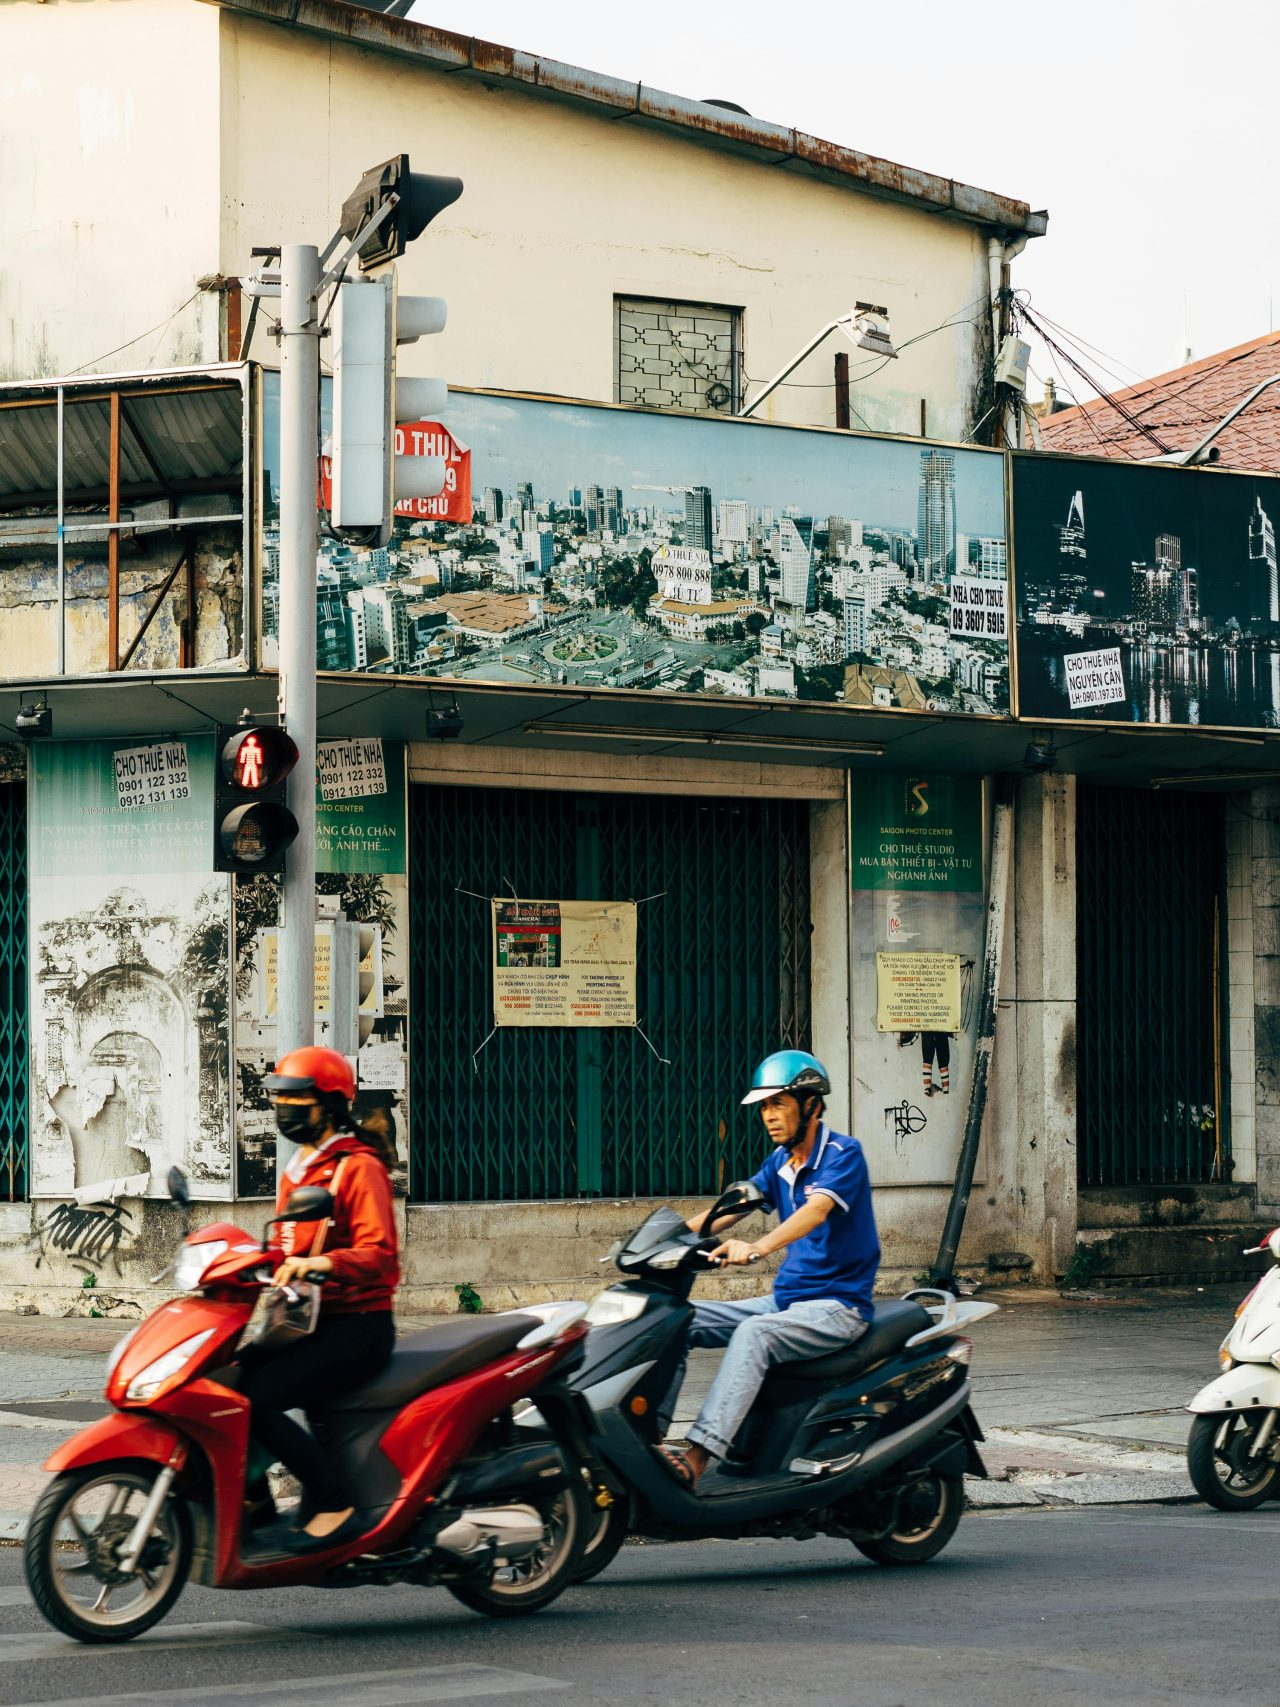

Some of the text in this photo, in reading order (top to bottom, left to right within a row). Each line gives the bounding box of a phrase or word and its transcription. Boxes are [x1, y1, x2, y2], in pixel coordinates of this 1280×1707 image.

[417, 494, 449, 516] CHỦ
[652, 562, 710, 584] 0978 800 888
[952, 580, 1004, 608] NHÀ CHO THUÊ
[952, 607, 1005, 635] 09 3607 5915
[1066, 650, 1119, 672] CHO THUÊ NHÀ
[1069, 670, 1104, 691] NGUYÊN
[1071, 686, 1123, 705] LH: 0901.197.318
[115, 755, 137, 778] CHO
[137, 746, 165, 775] THUÊ
[166, 743, 188, 770] NHÀ
[318, 738, 383, 770] CHO THUÊ NHÀ
[118, 772, 187, 793] 0901 122 332
[321, 767, 383, 786] 0901 122 332
[120, 787, 189, 807] 0912 131 139
[323, 782, 385, 800] 0912 131 139
[141, 803, 175, 814] CENTER
[334, 804, 365, 813] CENTER
[341, 823, 365, 838] CÁO,
[367, 824, 397, 837] CHÂN
[905, 827, 927, 835] PHOTO
[928, 828, 953, 836] CENTER
[336, 837, 359, 850] ẢNH
[879, 842, 955, 855] CHO THUÊ STUDIO
[859, 854, 973, 870] MUA BÁN THIẾT BỊ VẬT TƯ
[928, 868, 949, 881] ẢNH
